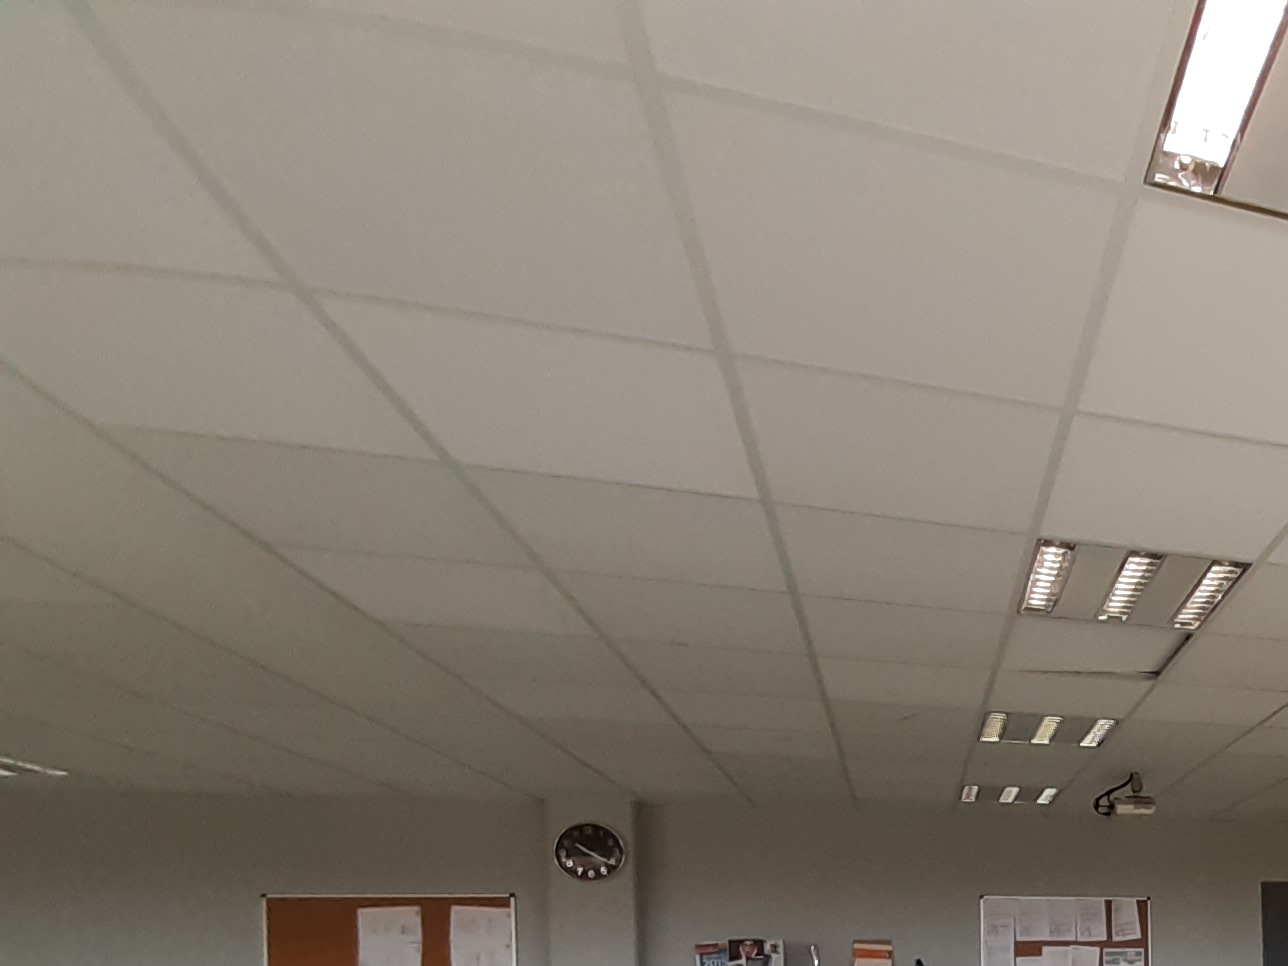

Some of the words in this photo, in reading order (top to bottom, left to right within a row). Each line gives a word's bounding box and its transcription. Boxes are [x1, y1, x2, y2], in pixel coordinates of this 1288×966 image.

[566, 858, 574, 868] 8
[576, 866, 584, 876] 7
[587, 869, 595, 878] 6
[600, 866, 608, 875] 5
